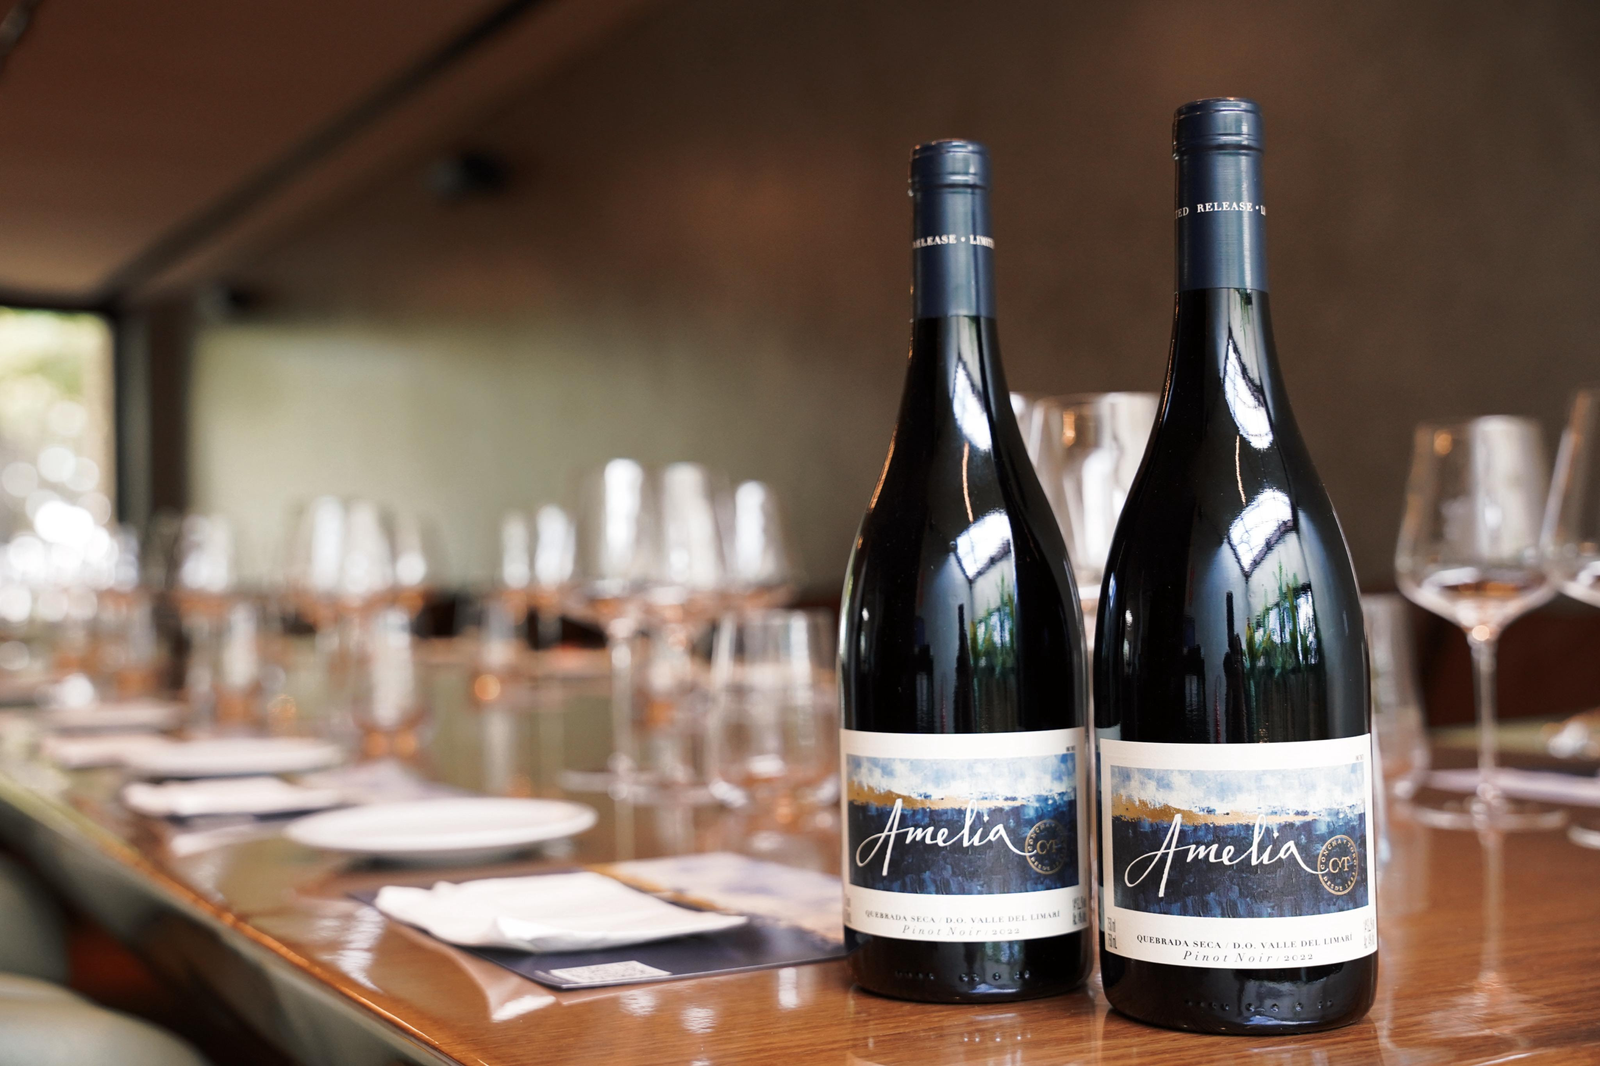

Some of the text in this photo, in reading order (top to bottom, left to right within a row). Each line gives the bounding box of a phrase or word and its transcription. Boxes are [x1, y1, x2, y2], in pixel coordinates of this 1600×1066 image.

[1196, 201, 1253, 213] RELEASE
[855, 798, 1037, 877] Amelia
[1124, 813, 1329, 897] Amelia
[1320, 839, 1342, 870] CONCHA
[1323, 876, 1343, 891] DESDE
[865, 909, 908, 922] QUEBRADA
[910, 915, 936, 924] SECA
[945, 916, 967, 924] D.O.
[970, 916, 1005, 924] VALLE
[1008, 914, 1027, 923] DEL
[902, 924, 941, 936] Pinot
[947, 926, 981, 937] Noir
[991, 928, 1020, 936] 2022
[1136, 934, 1189, 948] QUEBRADA
[1192, 940, 1221, 949] SECA
[1233, 942, 1256, 950] D.O.
[1260, 941, 1297, 949] VALLE
[1300, 939, 1320, 948] DEL
[1323, 932, 1353, 946] LIMARÍ
[1183, 950, 1228, 962] Pinot
[1235, 952, 1272, 963] Noir
[1284, 953, 1313, 962] 2022
